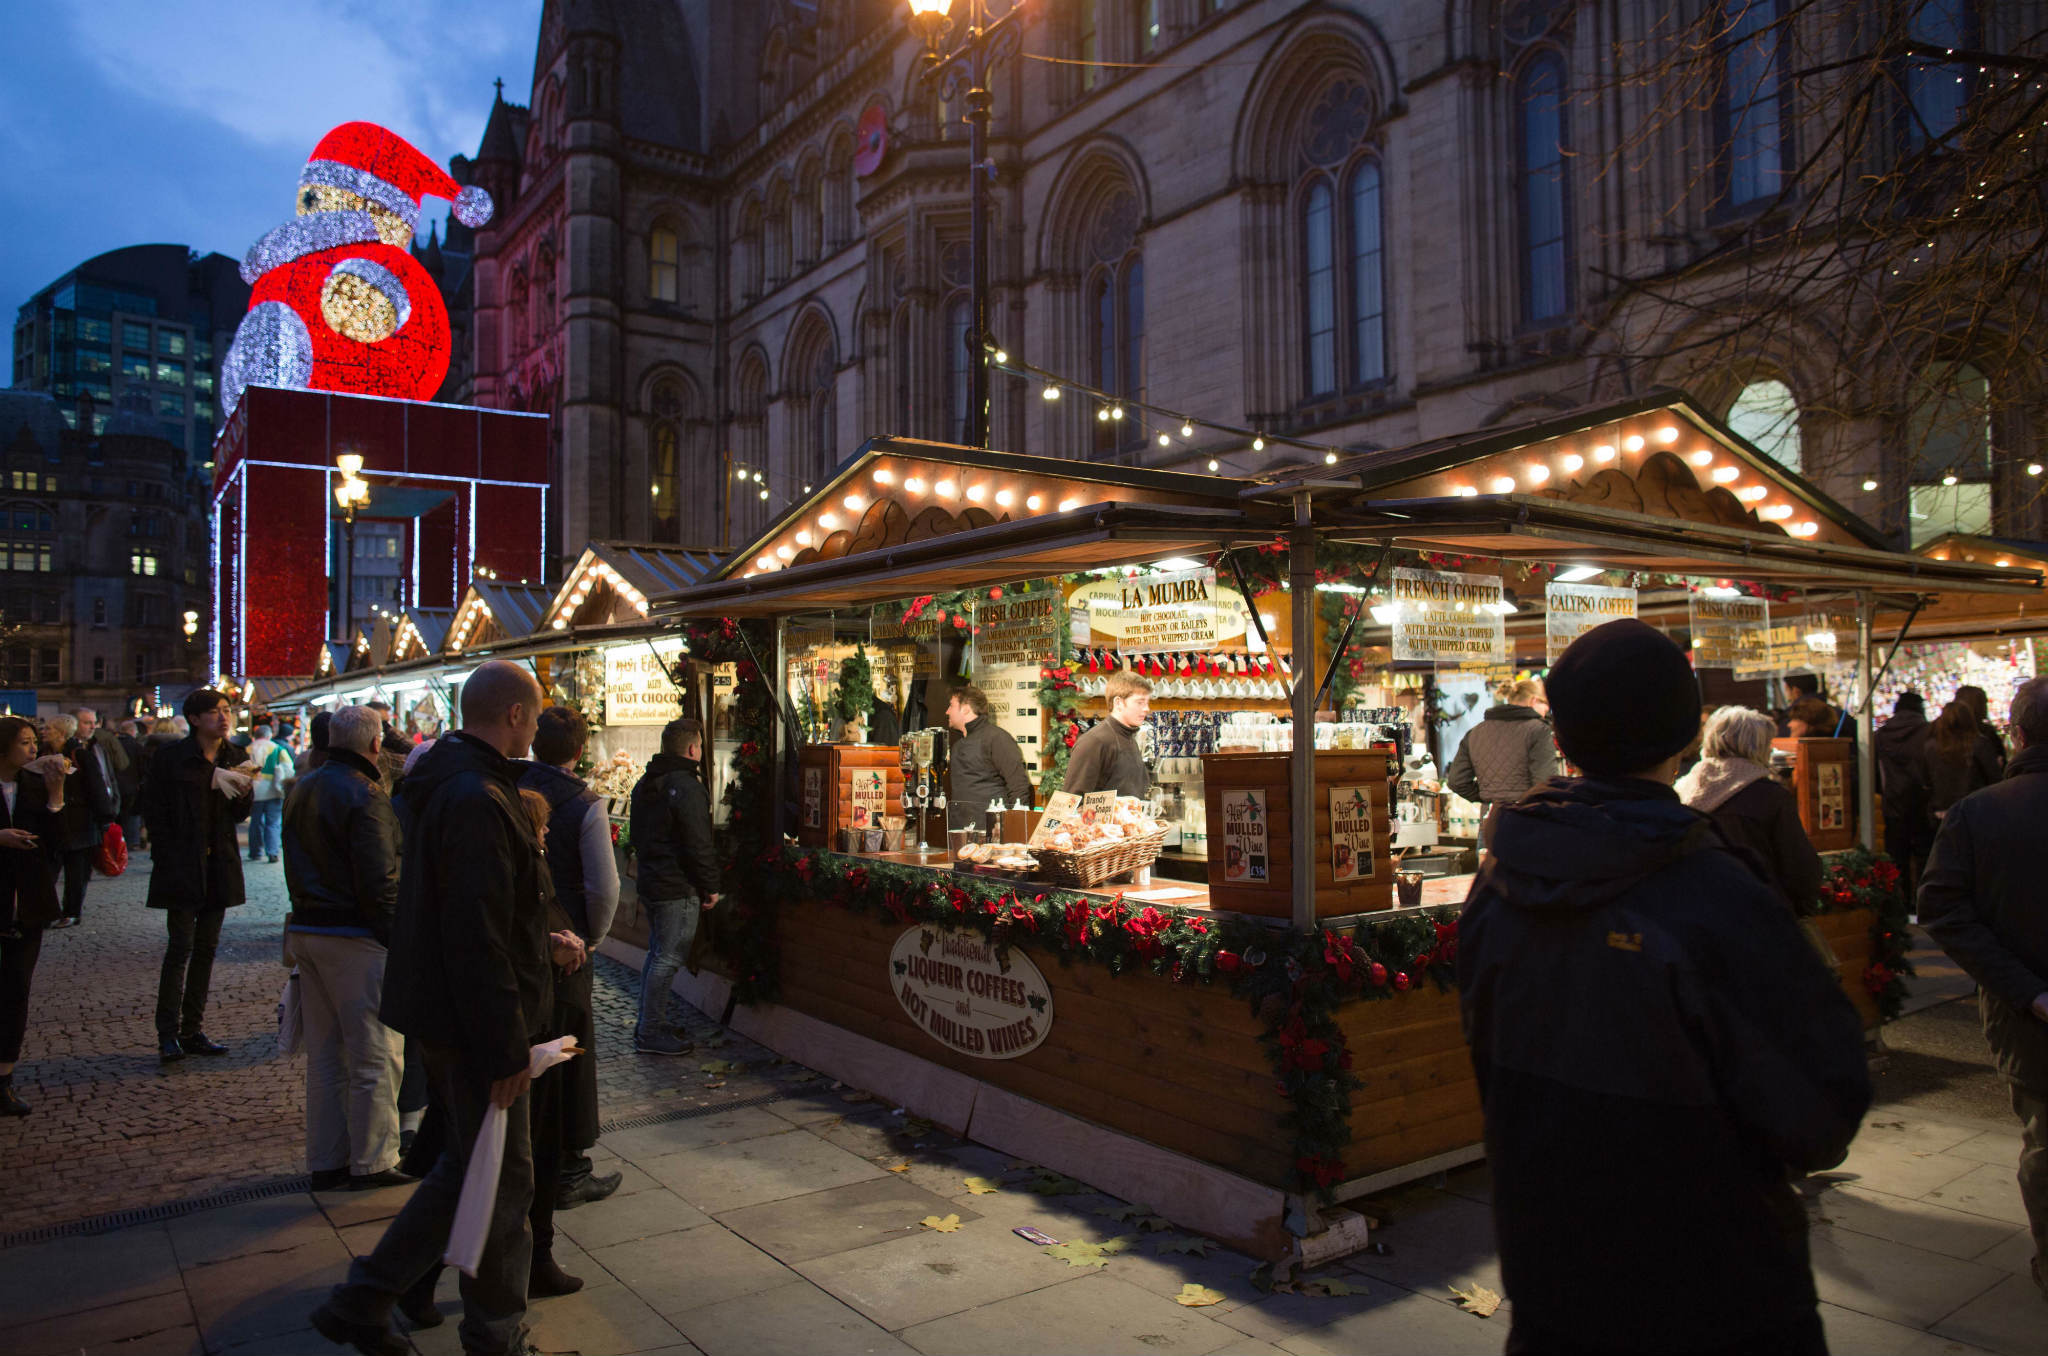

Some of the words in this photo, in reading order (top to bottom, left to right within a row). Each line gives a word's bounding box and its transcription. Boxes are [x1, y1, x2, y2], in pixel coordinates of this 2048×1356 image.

[1122, 587, 1143, 610] LA
[1148, 579, 1208, 607] MUMBA
[1395, 578, 1449, 600] FRENCH
[1454, 584, 1500, 605] COFFEE
[980, 604, 1007, 623] IRISH
[1010, 598, 1051, 620] COFFEE
[1551, 594, 1595, 613] CALYPSO
[1598, 597, 1634, 616] COFFEE
[1140, 613, 1152, 623] HOT
[1153, 610, 1190, 621] CHOCOLATE
[1424, 611, 1447, 622] LATTE
[1125, 624, 1142, 635] WITH
[1143, 622, 1167, 634] BRANDY
[1170, 620, 1179, 631] OR
[1181, 618, 1208, 630] BAILEYS
[1405, 624, 1425, 636] WITH
[1428, 625, 1457, 637] BRANDY
[1459, 628, 1465, 637] &
[1468, 627, 1495, 639] TOPPED
[1143, 635, 1159, 645] WITH
[1161, 633, 1189, 643] WHIPPED
[1190, 630, 1215, 641] CREAM
[1553, 635, 1569, 645] WITH
[978, 643, 993, 653] WITH
[995, 641, 1021, 652] WHISKEY
[1031, 638, 1054, 649] TOPPED
[1408, 638, 1429, 650] WITH
[1432, 640, 1465, 652] WHIPPED
[1467, 641, 1492, 653] CREAM
[982, 655, 997, 665] WITH
[999, 652, 1025, 663] WHIPPED
[1027, 650, 1049, 661] CREAM
[617, 692, 638, 704] HOT
[642, 691, 684, 704] CHOCO
[856, 778, 872, 791] Hot
[855, 791, 883, 800] MULLED
[1085, 795, 1106, 805] Brandy
[862, 800, 883, 812] Wine
[1095, 805, 1112, 814] Snaps
[1226, 803, 1249, 821] Hot
[1334, 801, 1356, 820] Hot
[1226, 822, 1264, 836] MULLED
[1334, 819, 1370, 834] MULLED
[1236, 835, 1263, 854] Wine
[1345, 833, 1370, 851] Wine
[908, 955, 963, 993] LIQUEUR
[966, 969, 1027, 1008] COFFEES
[955, 998, 971, 1018] and
[901, 981, 929, 1025] HOT
[930, 1009, 985, 1054] MULLED
[987, 1016, 1038, 1055] WINES
